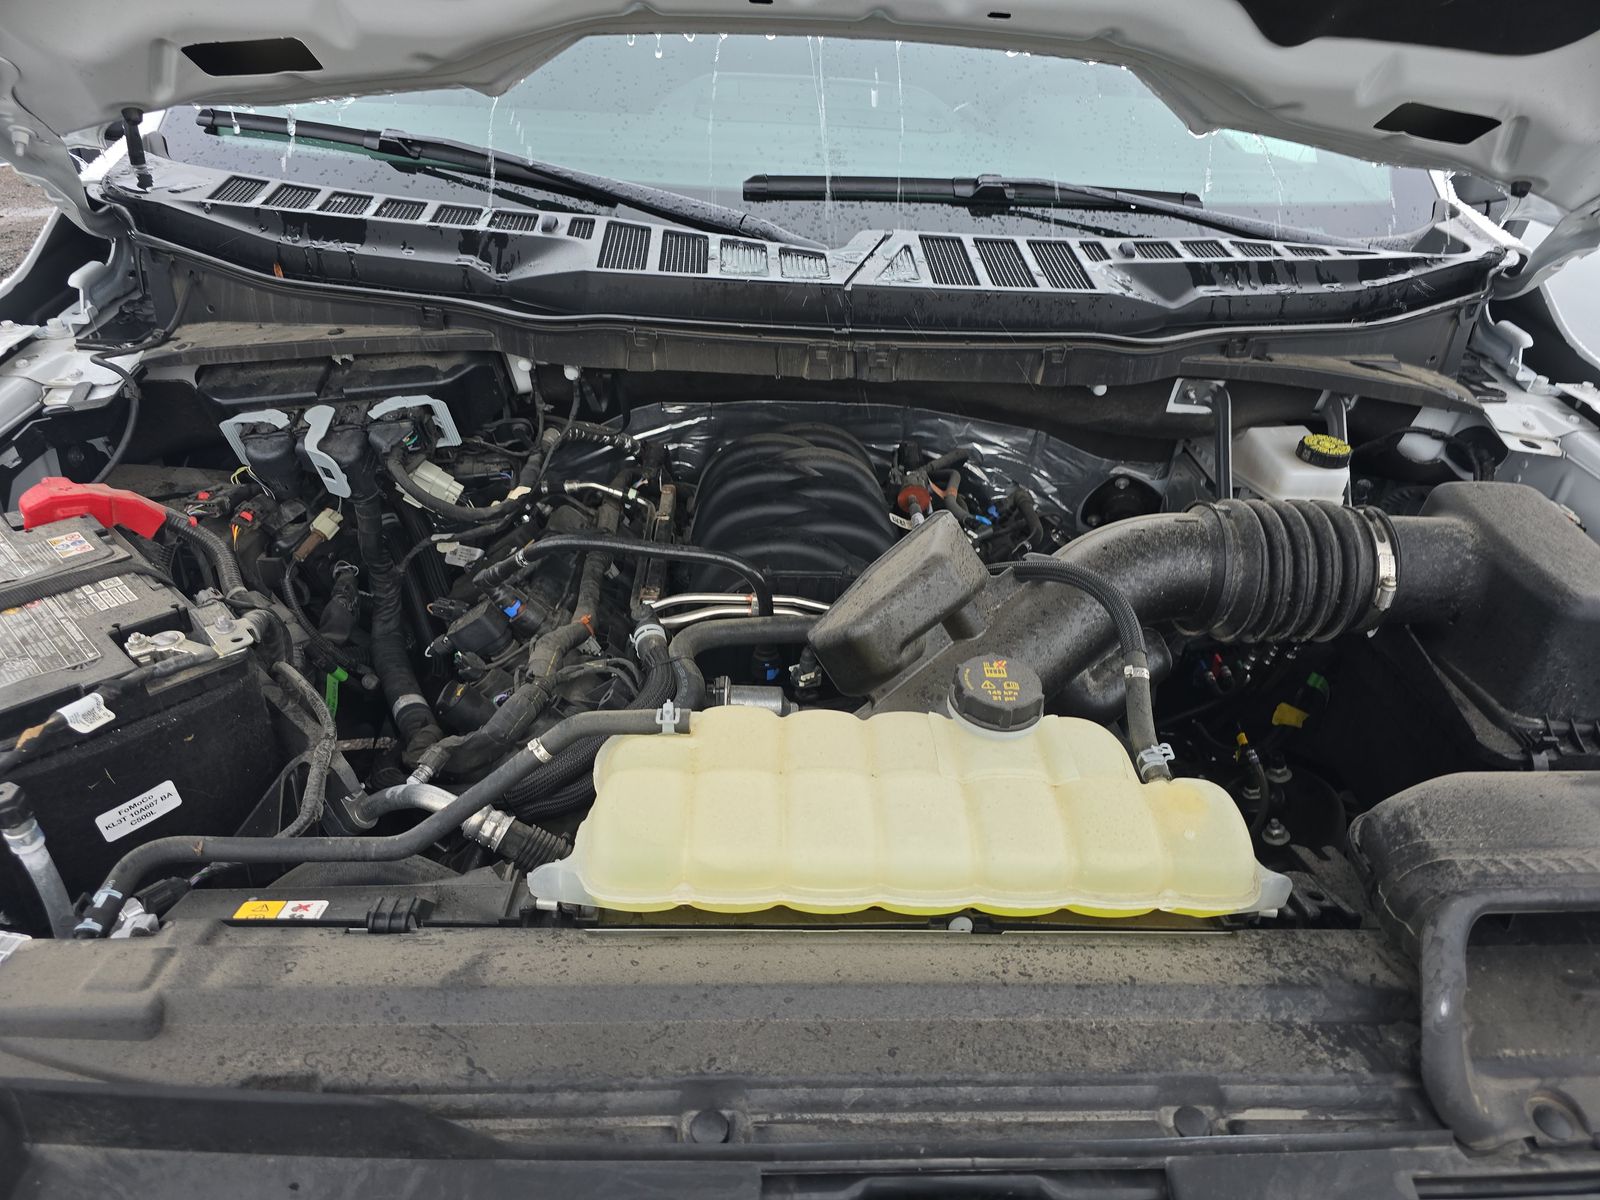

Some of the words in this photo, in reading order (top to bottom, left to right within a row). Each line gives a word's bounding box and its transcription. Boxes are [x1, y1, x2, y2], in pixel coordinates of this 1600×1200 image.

[105, 816, 127, 830] KL3T
[160, 792, 173, 802] BA
[118, 795, 154, 816] FoMoCo
